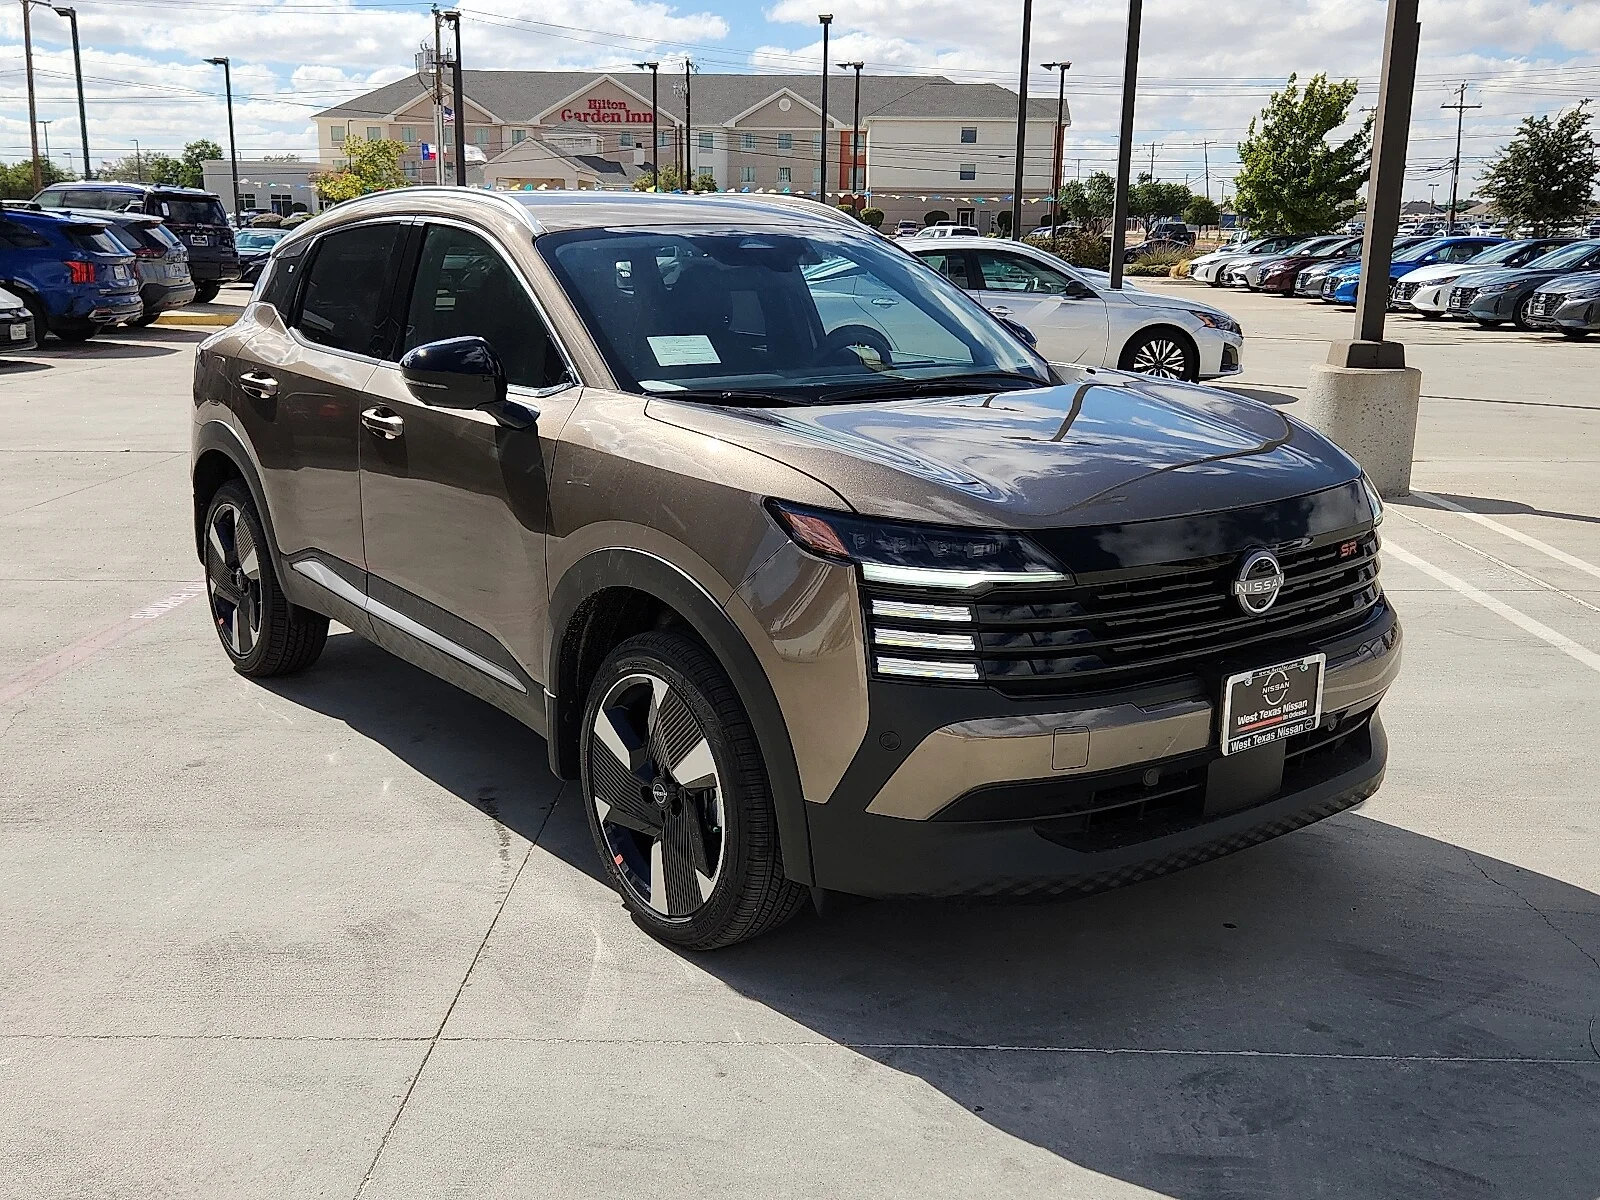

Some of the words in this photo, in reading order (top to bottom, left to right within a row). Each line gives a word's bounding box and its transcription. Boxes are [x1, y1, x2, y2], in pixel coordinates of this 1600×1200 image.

[588, 99, 626, 110] Hilton
[561, 109, 622, 123] Garden
[624, 109, 654, 123] Inn
[1340, 541, 1358, 558] SR
[1236, 573, 1284, 594] NISSAN
[1262, 681, 1290, 694] NISSAN
[1237, 713, 1258, 726] West
[1259, 707, 1282, 720] Texas
[1282, 699, 1308, 713] Nissan
[1230, 738, 1251, 752] West
[1253, 731, 1276, 745] Texas
[1277, 723, 1304, 738] Nissan
